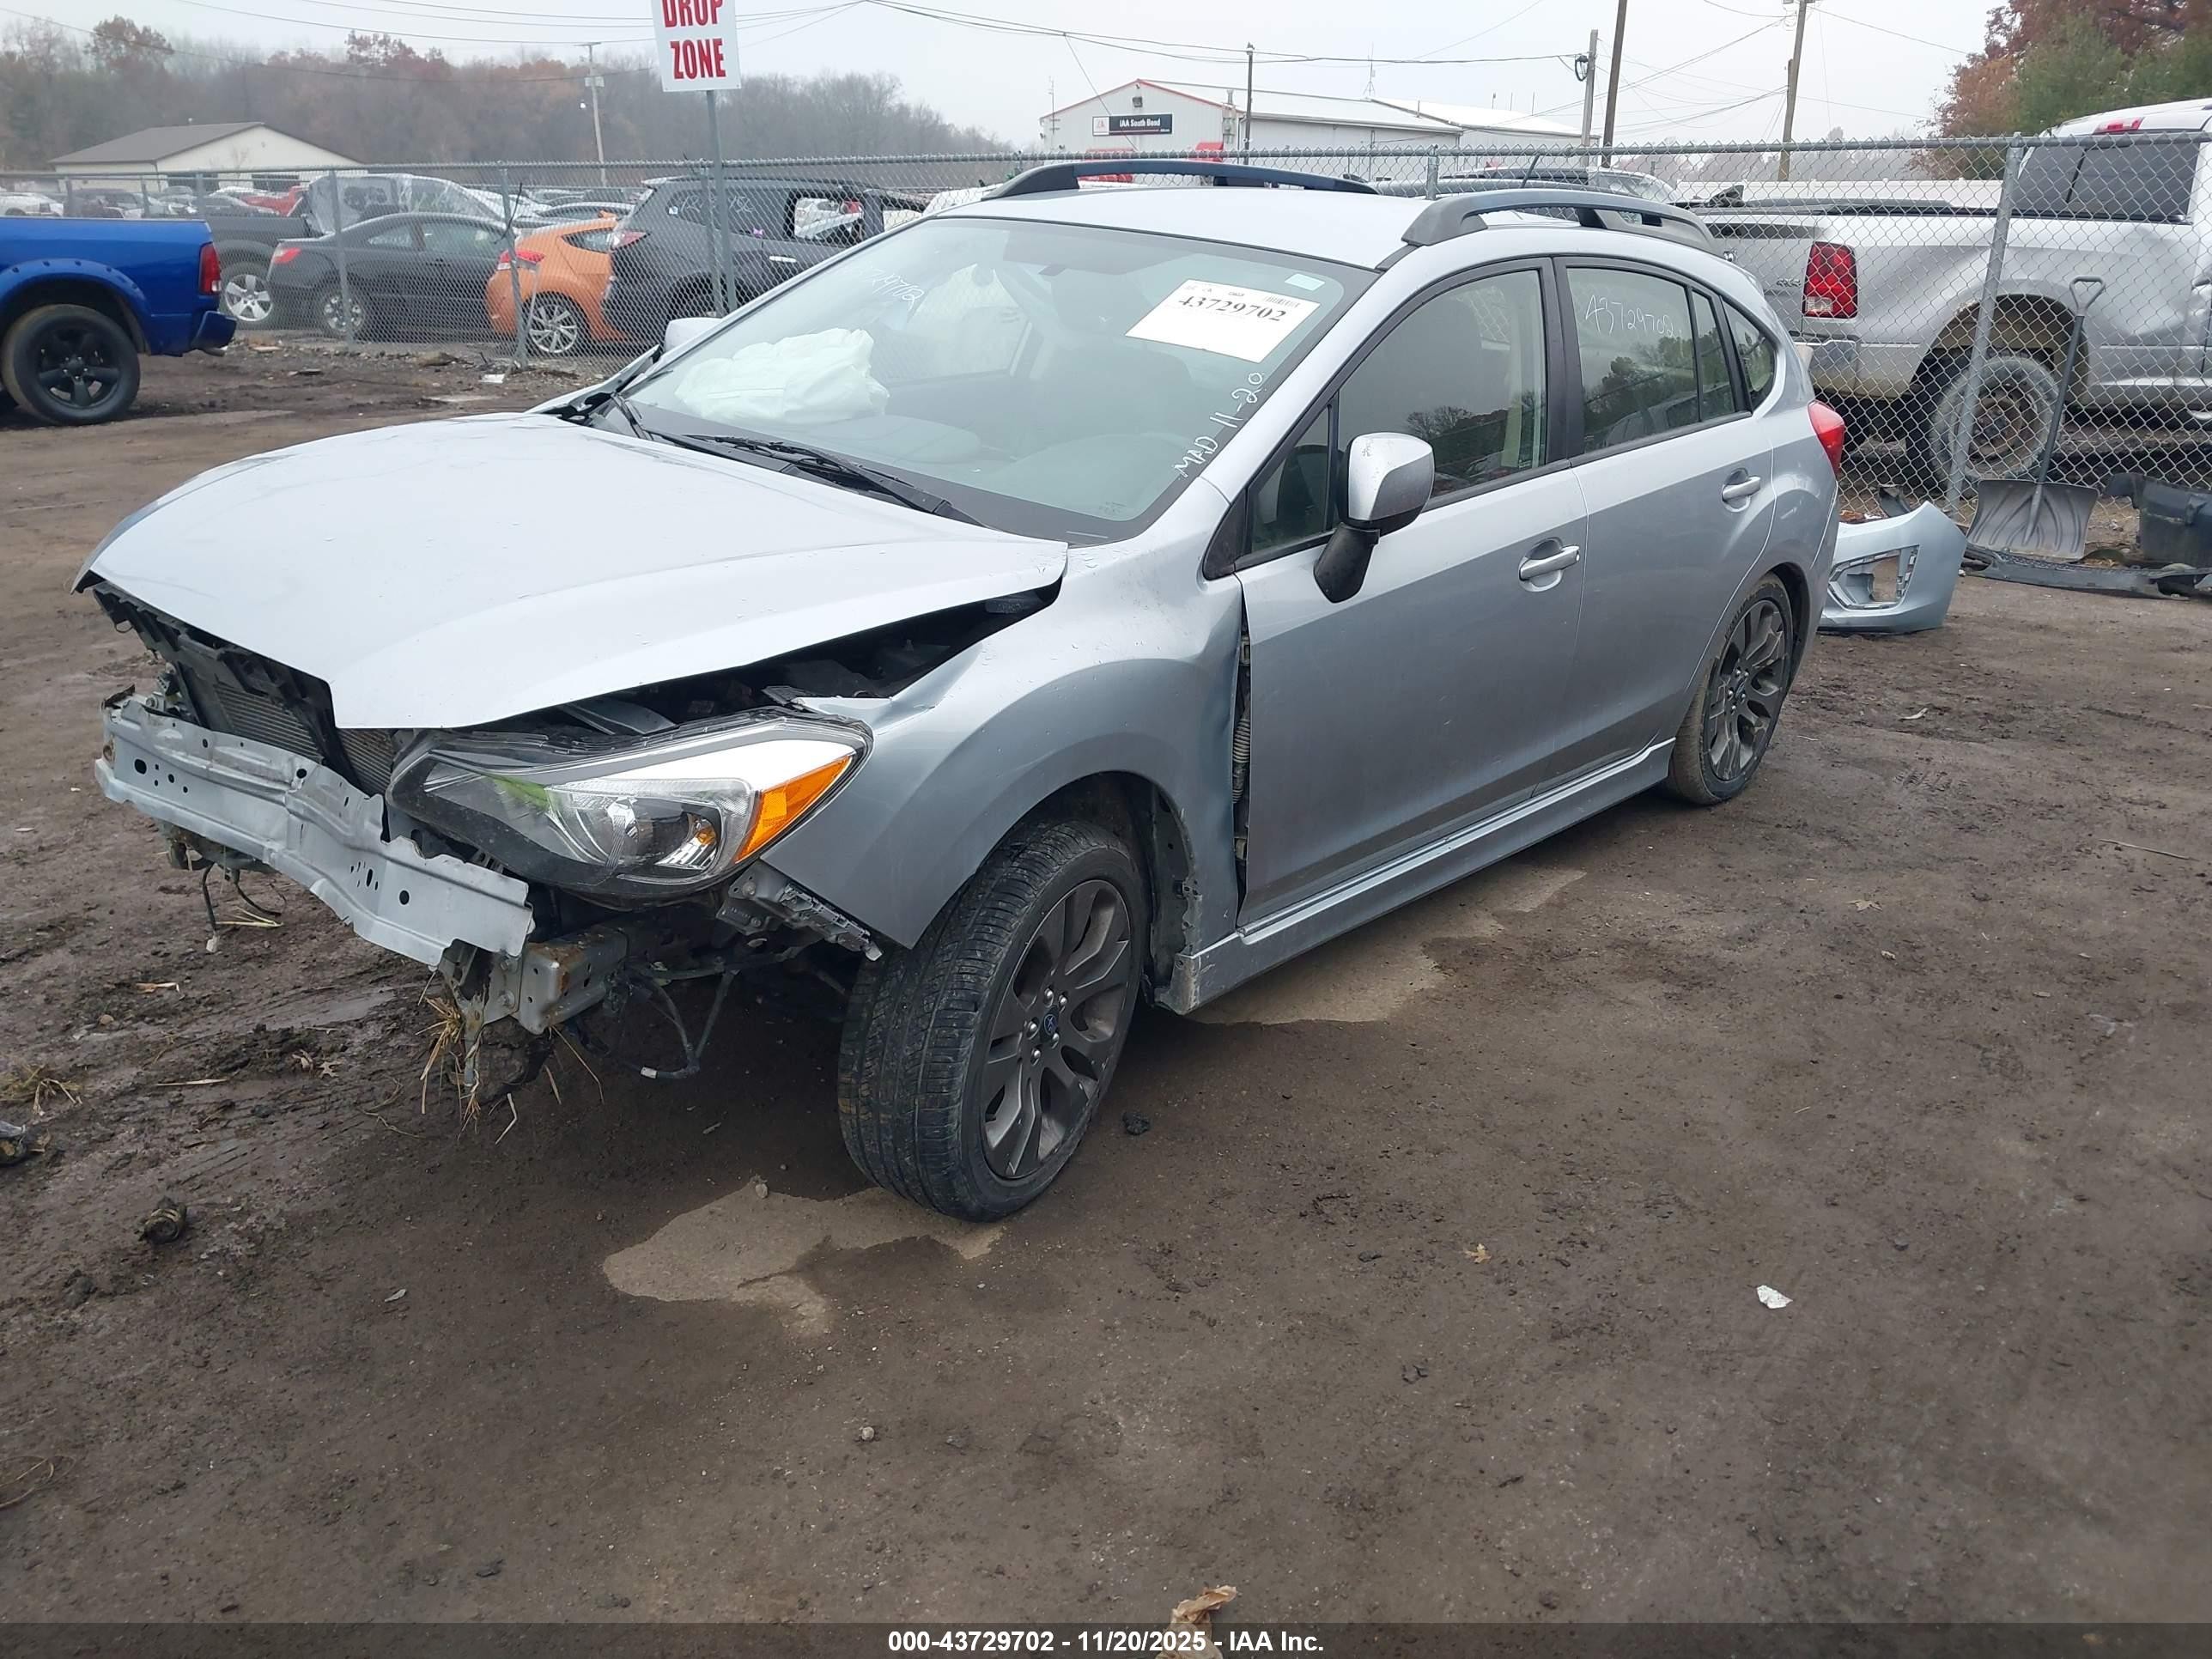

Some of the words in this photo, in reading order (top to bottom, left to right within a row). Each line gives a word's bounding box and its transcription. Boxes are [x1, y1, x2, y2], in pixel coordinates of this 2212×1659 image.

[662, 0, 723, 27] DROP
[670, 38, 726, 79] ZONE
[1131, 118, 1146, 127] South
[1147, 118, 1161, 126] Bend
[1178, 295, 1286, 322] 43729702
[1585, 295, 1674, 337] 43729702
[1174, 435, 1218, 478] MAD
